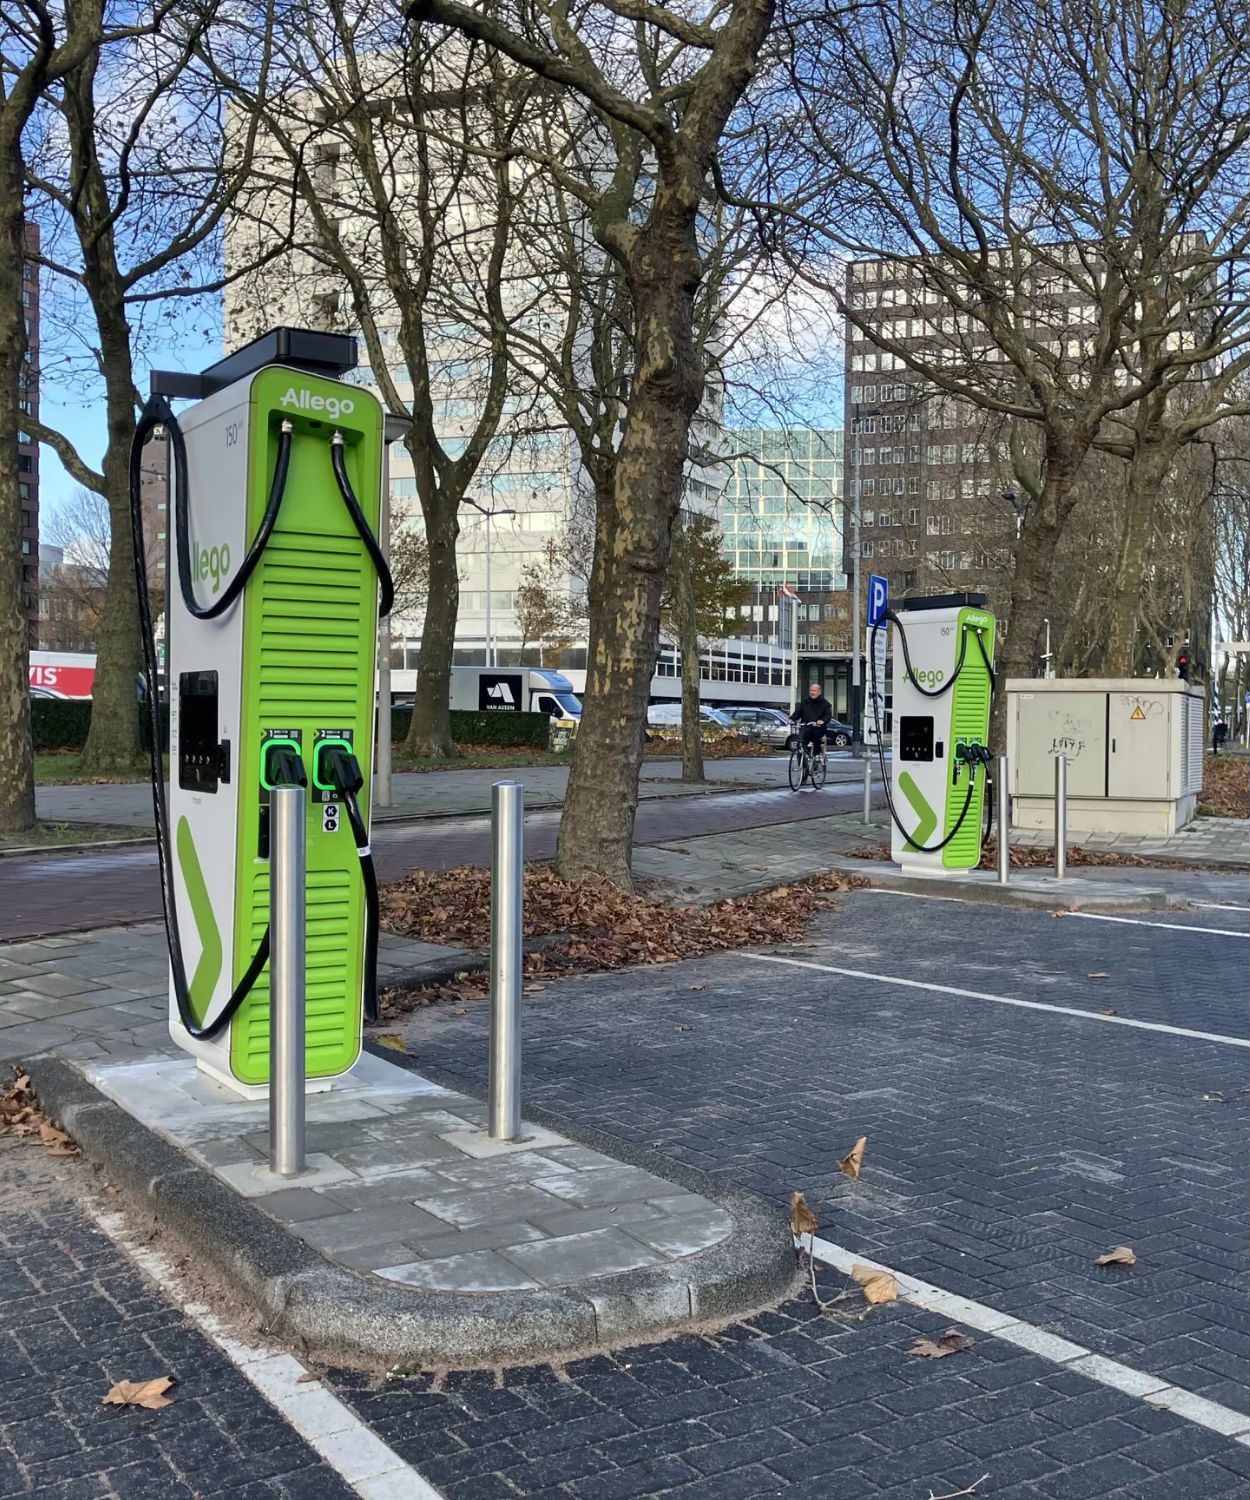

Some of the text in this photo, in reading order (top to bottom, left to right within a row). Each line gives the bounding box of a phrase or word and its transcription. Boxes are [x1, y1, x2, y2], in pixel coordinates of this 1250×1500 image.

[280, 387, 355, 419] Allego
[225, 422, 238, 449] 150
[191, 541, 231, 594] llego
[873, 582, 884, 620] P
[966, 614, 988, 625] Allego
